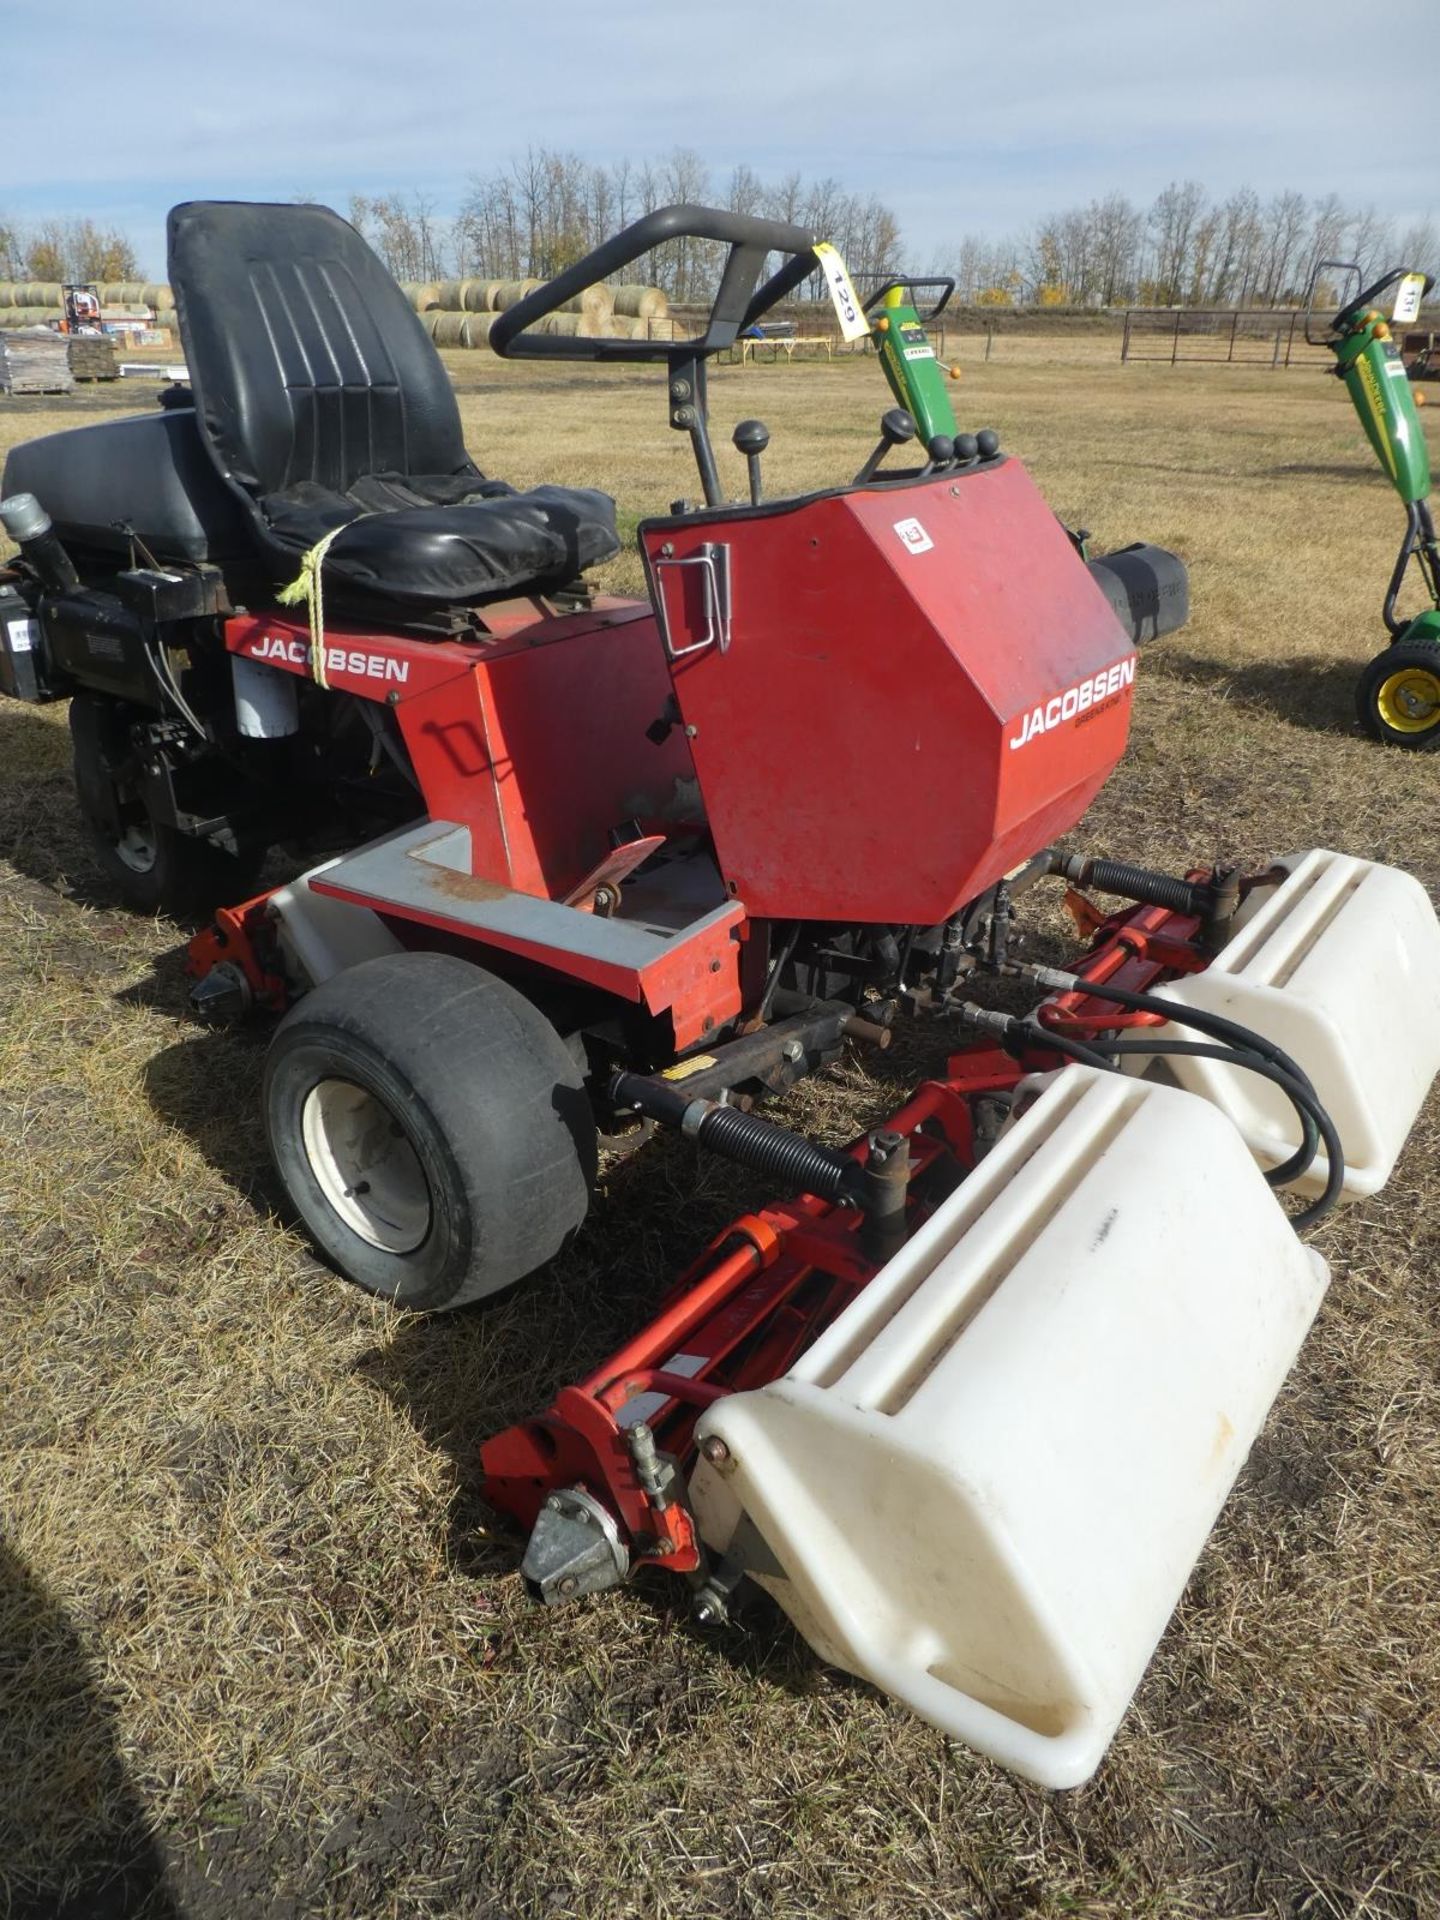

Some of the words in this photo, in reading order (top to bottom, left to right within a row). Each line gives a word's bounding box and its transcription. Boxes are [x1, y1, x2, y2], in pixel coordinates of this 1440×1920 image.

[835, 270, 855, 323] 129
[1402, 291, 1416, 312] 131
[1010, 657, 1136, 749] JACOBSEN
